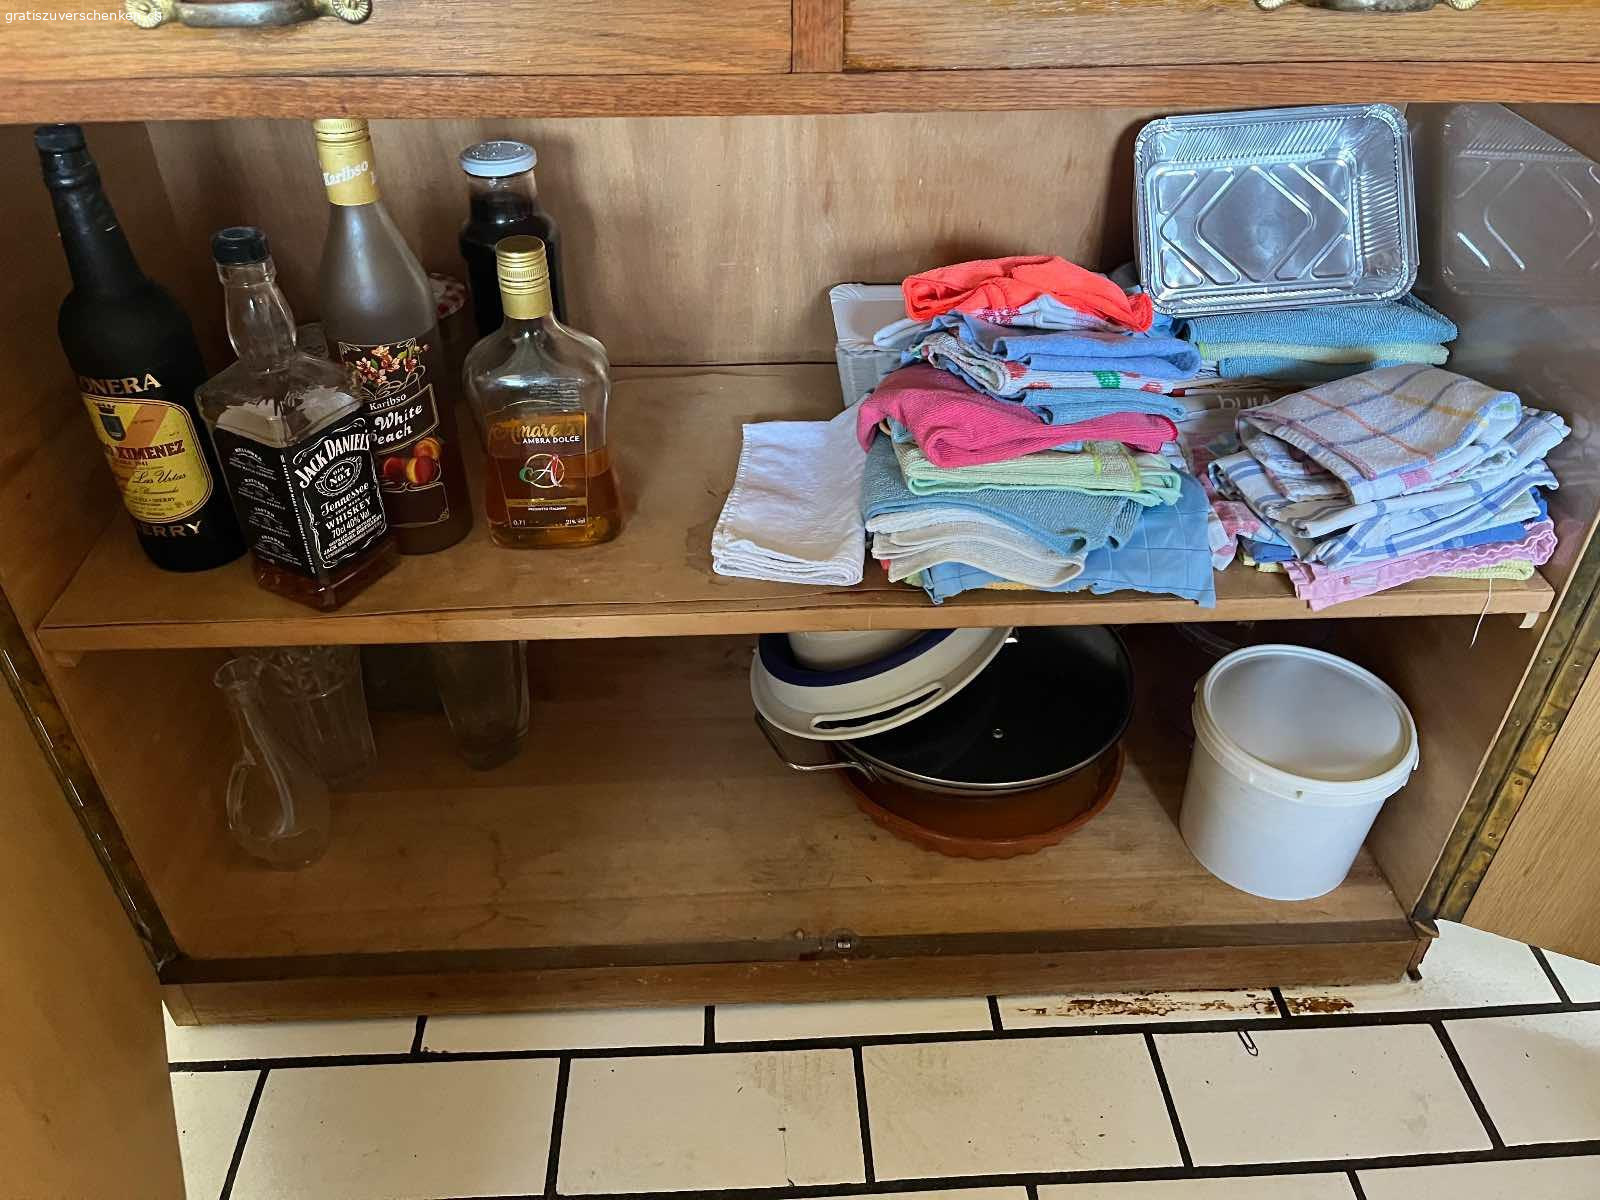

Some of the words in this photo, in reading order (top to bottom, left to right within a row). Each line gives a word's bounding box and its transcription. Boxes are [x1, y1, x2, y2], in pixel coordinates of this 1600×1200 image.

[369, 393, 407, 411] Karibso
[374, 404, 423, 432] White
[117, 440, 186, 460] XIMENEZ
[522, 437, 551, 445] AMBRA
[552, 435, 581, 444] DOLCE
[294, 450, 328, 489] JACK
[324, 429, 370, 461] DANIEL'S
[330, 467, 350, 487] No.7
[321, 482, 368, 517] Tennessee
[326, 496, 370, 530] WHISKEY
[142, 520, 202, 537] ERRY
[331, 523, 346, 539] 70cl
